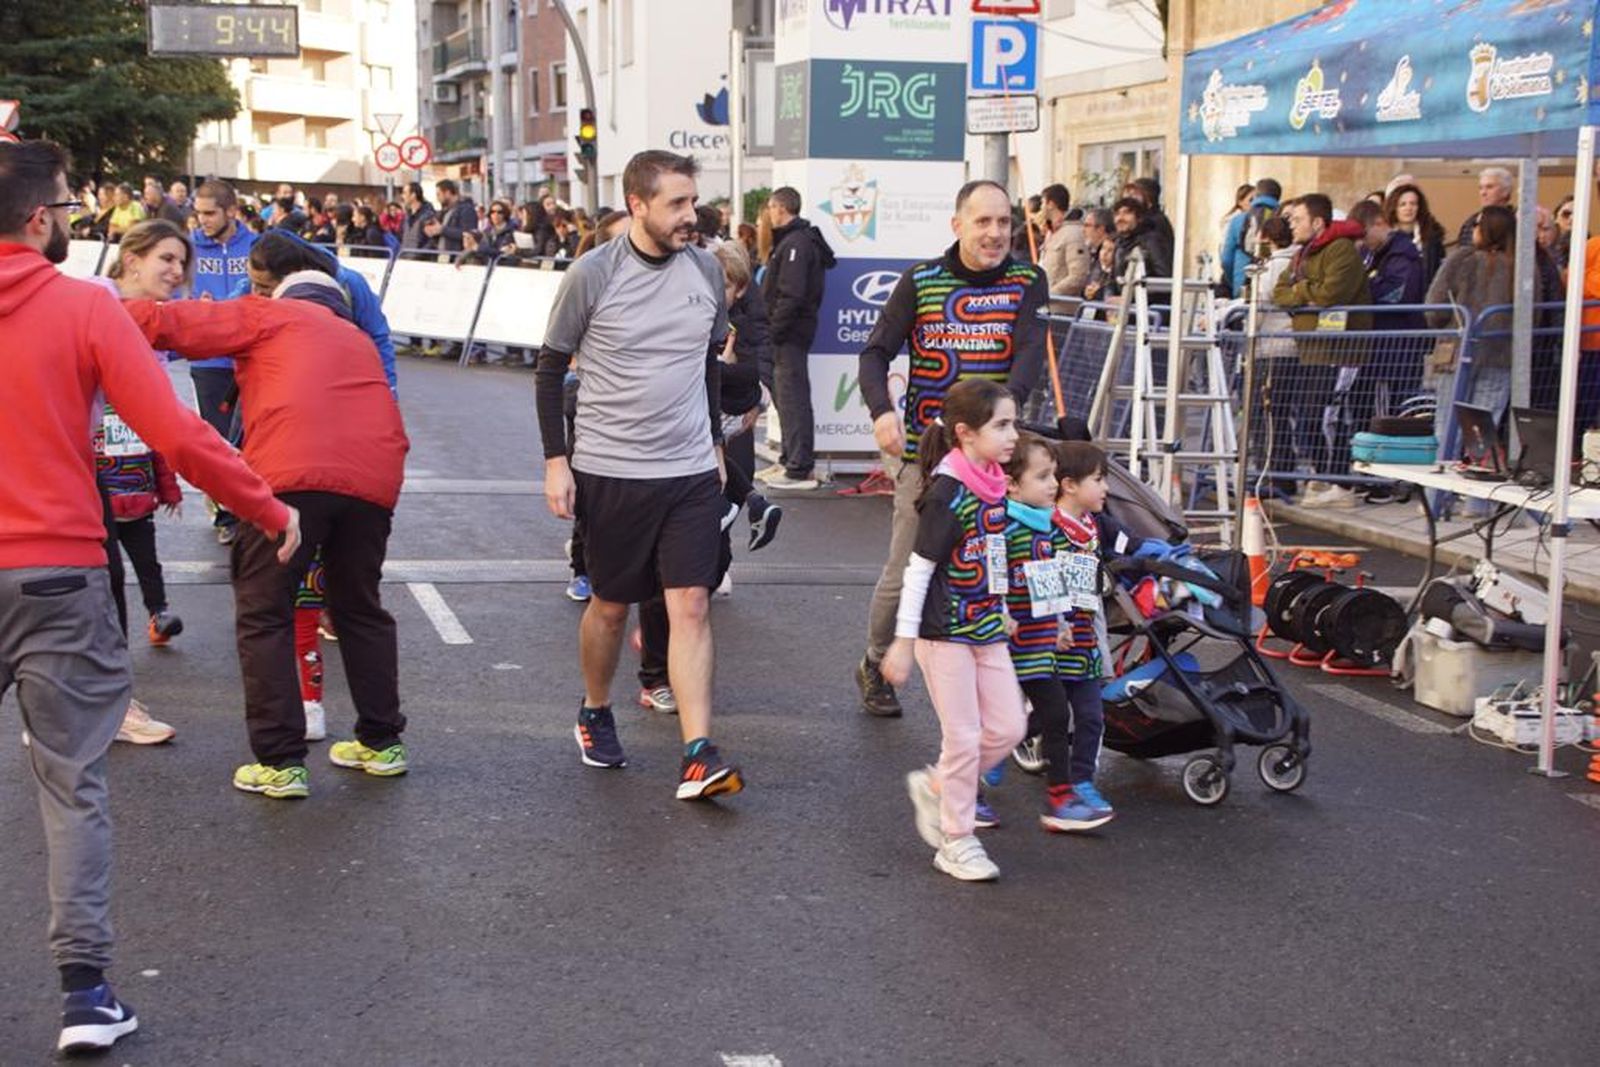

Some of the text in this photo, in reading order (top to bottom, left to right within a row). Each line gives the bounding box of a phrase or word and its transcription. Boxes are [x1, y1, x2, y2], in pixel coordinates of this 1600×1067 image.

[216, 15, 289, 44] 9:44
[982, 25, 1027, 85] P
[837, 326, 875, 343] Ges
